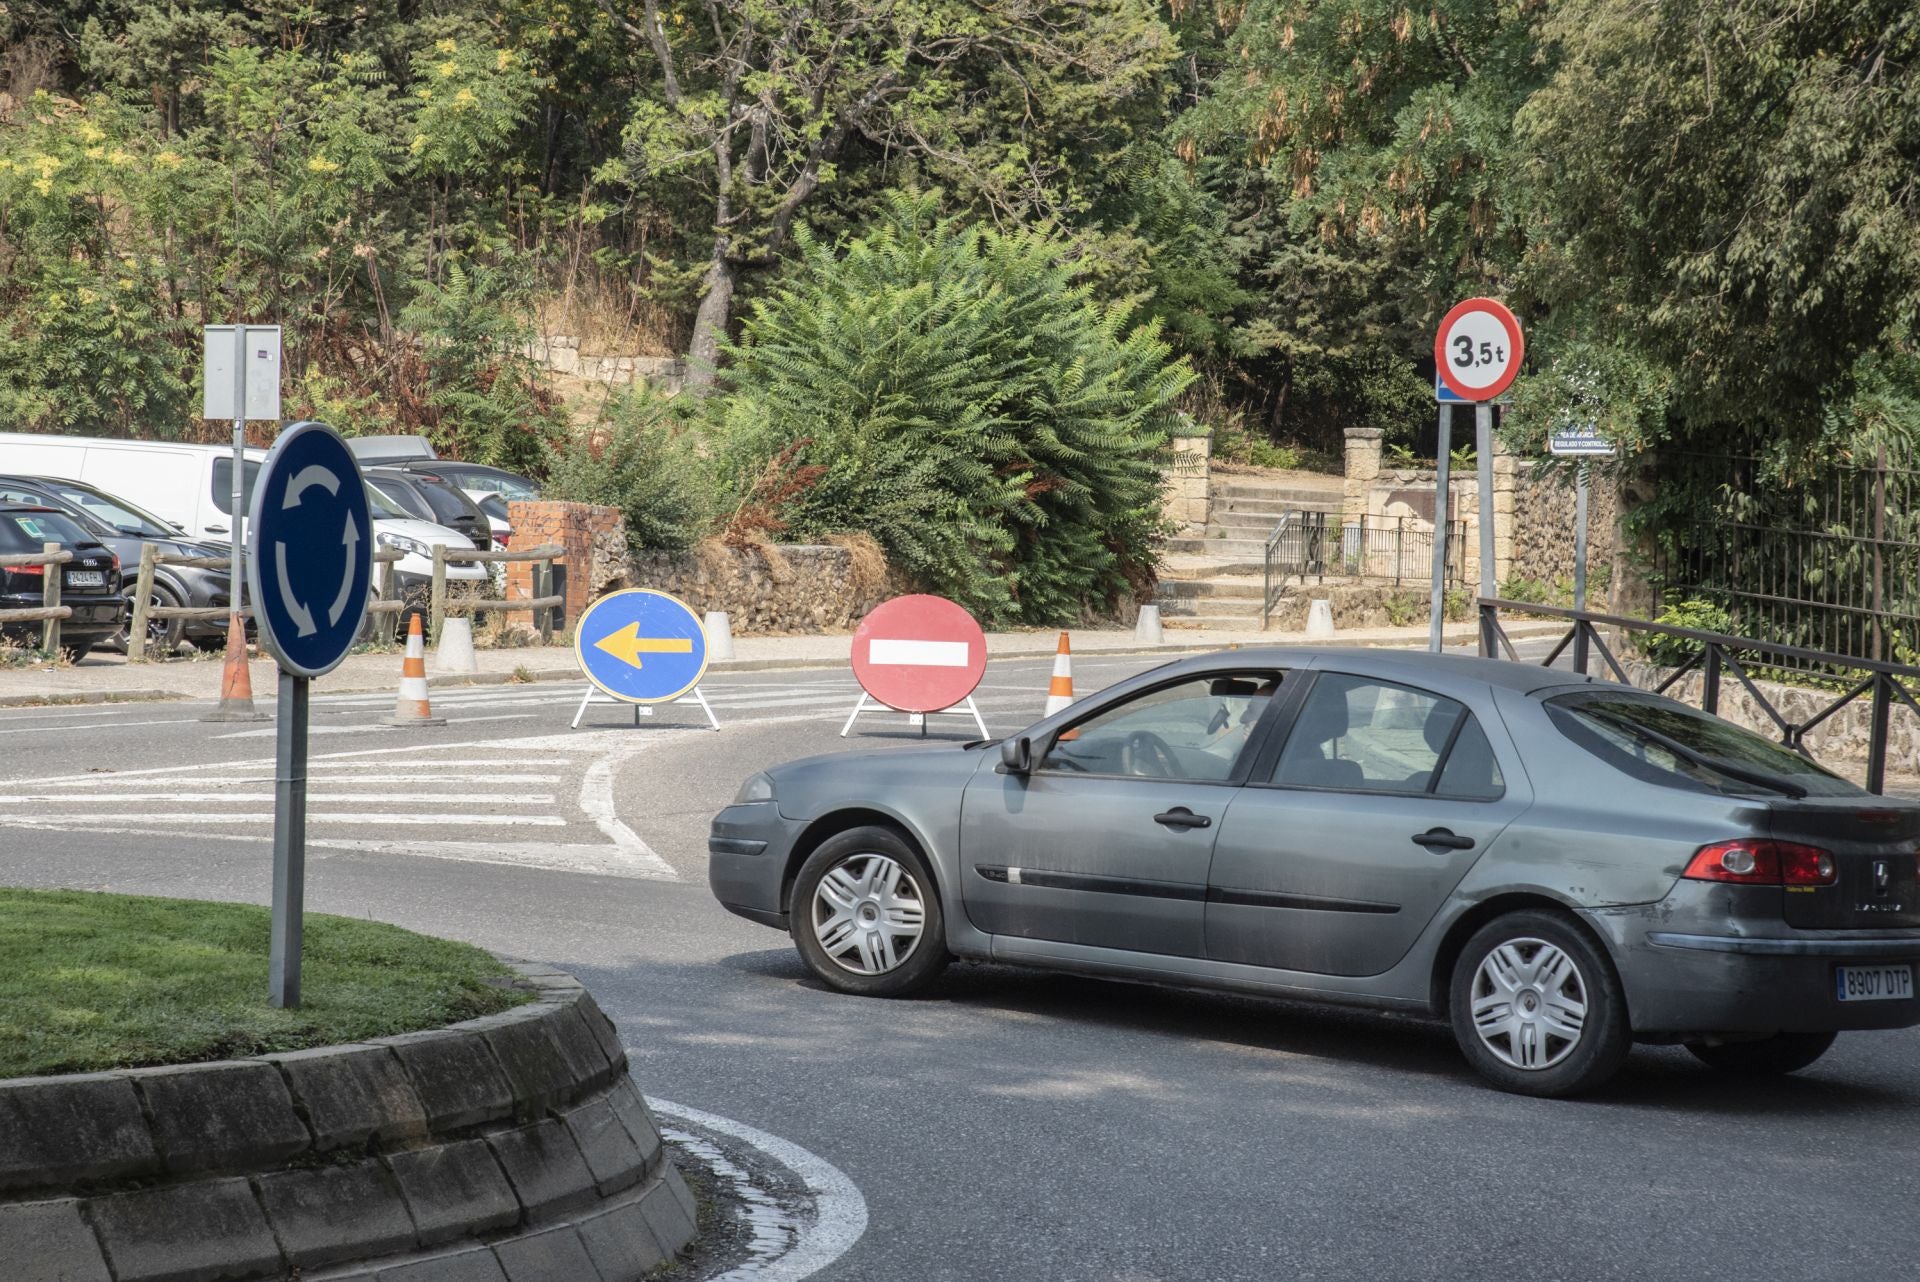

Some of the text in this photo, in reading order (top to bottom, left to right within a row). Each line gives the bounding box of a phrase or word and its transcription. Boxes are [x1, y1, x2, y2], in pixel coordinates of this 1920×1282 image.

[71, 572, 89, 583] 2424
[1847, 969, 1909, 995] 8907 DTP
